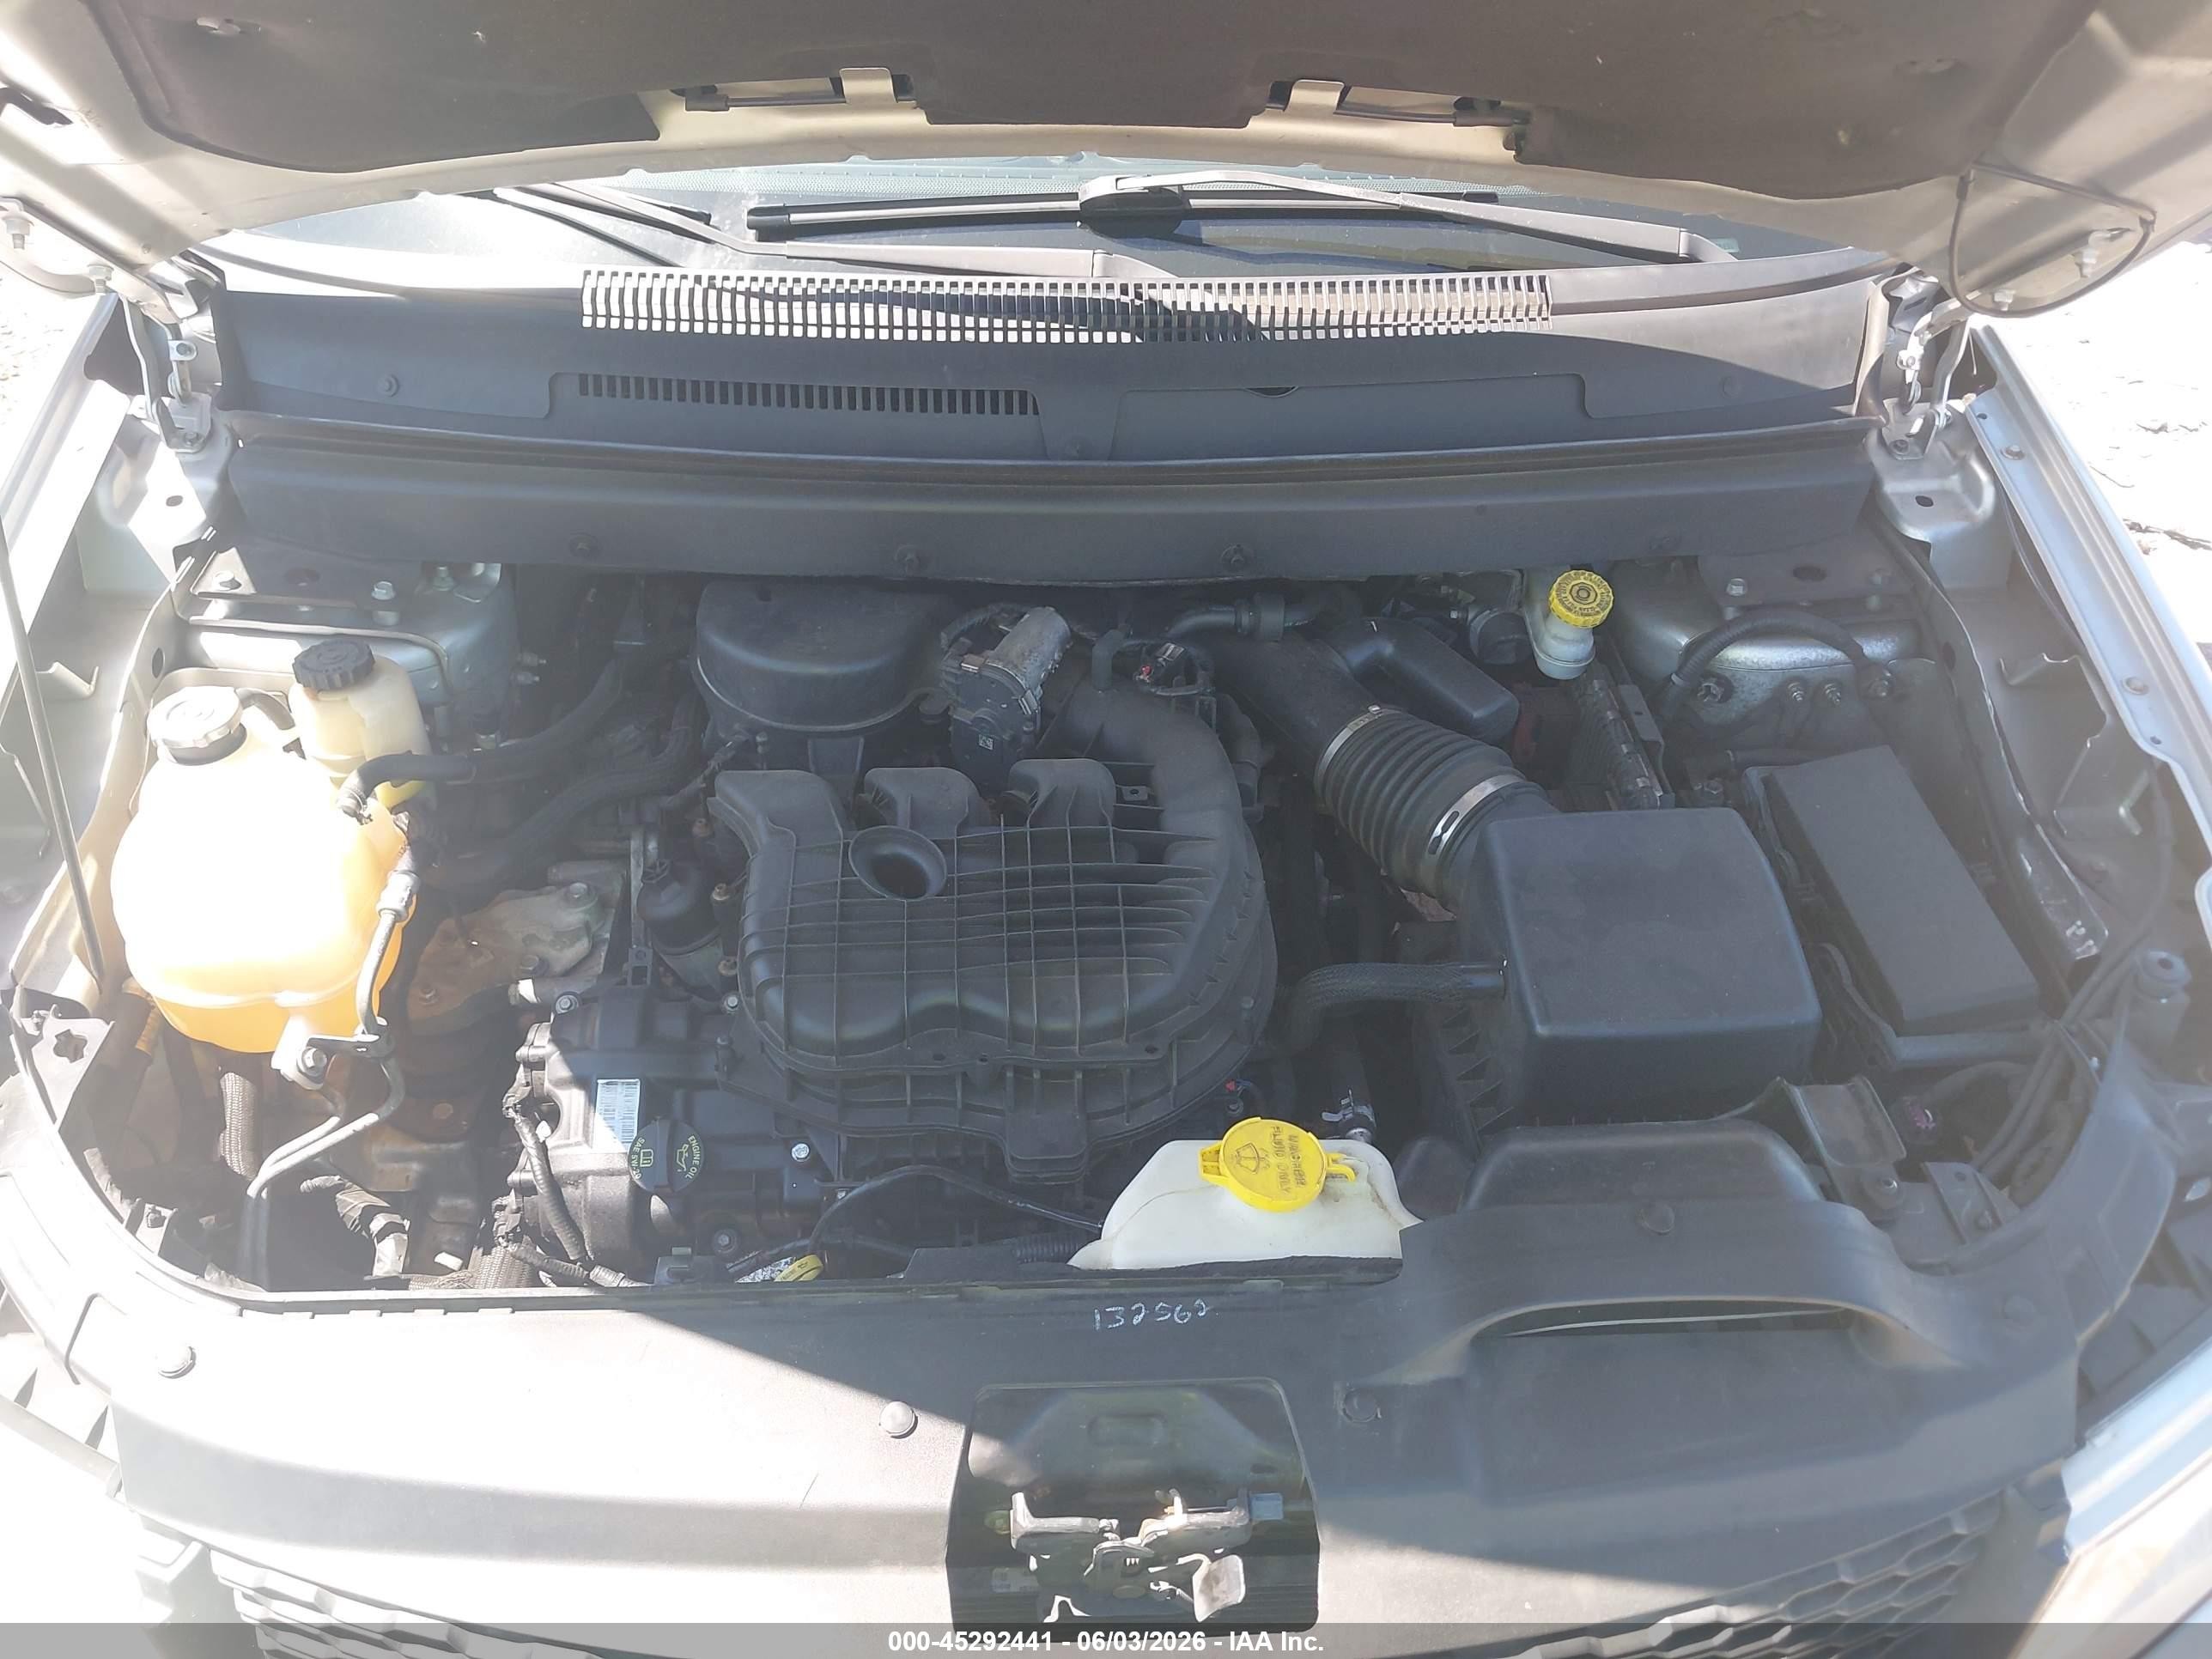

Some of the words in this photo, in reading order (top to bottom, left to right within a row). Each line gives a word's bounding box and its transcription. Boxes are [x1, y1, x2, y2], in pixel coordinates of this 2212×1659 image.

[632, 1137, 646, 1154] SAE
[688, 1135, 702, 1166] ENGINE
[630, 1154, 642, 1180] 5W-20
[685, 1166, 698, 1179] OIL
[1094, 1298, 1211, 1331] 132562
